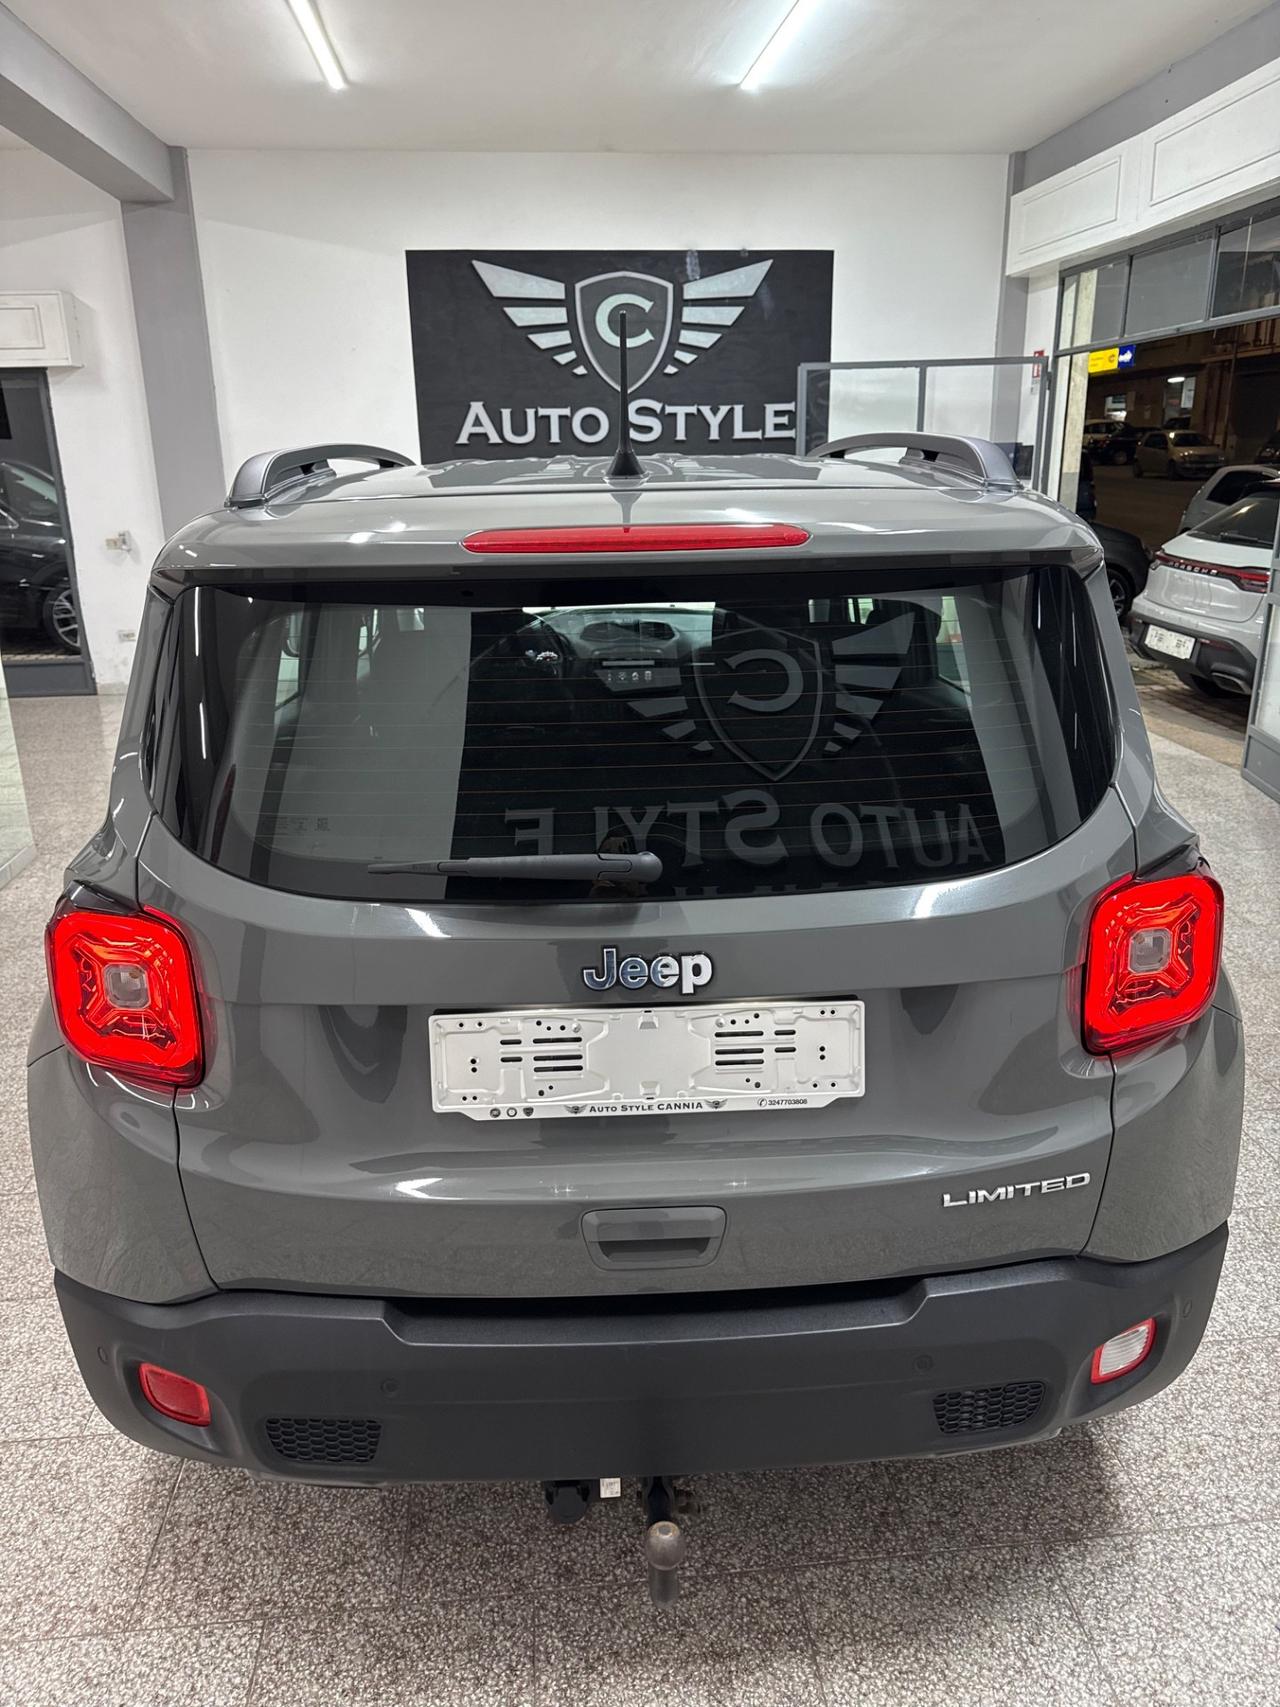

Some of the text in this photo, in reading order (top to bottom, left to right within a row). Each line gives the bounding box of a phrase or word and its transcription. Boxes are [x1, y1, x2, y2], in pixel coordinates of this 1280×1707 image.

[595, 293, 655, 348] C
[455, 399, 796, 444] AUTO STYLE
[583, 948, 713, 995] Jeep
[589, 1102, 703, 1113] AUTO STYLE CANNIA
[943, 1172, 1091, 1207] LIMITED
